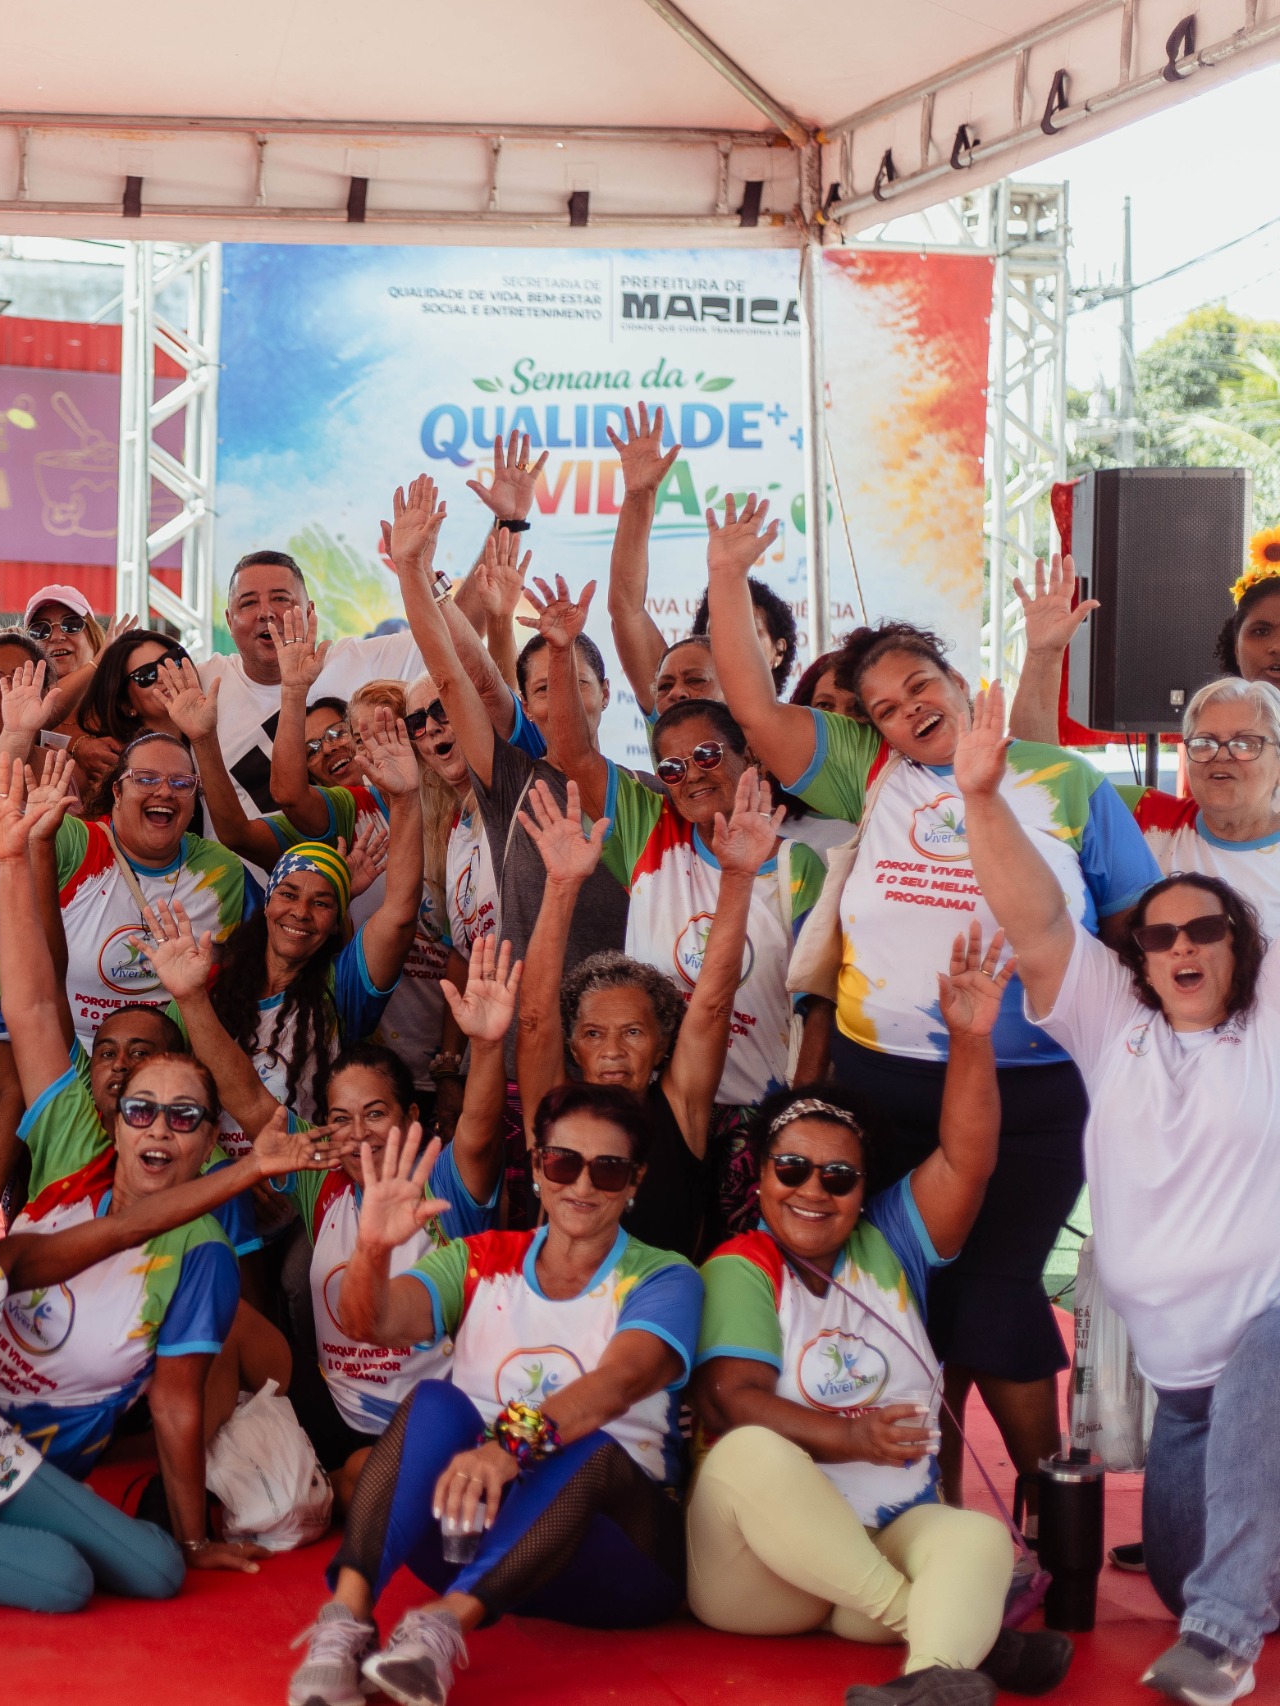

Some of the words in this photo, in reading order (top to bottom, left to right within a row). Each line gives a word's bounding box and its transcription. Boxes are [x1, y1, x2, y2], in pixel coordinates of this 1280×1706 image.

[502, 276, 581, 290] SECRETARIA
[584, 280, 601, 290] DE
[621, 275, 719, 292] PREFEITURA
[725, 279, 746, 292] DE
[388, 286, 463, 300] QUALIDADE
[469, 290, 485, 300] DE
[422, 302, 466, 315] SOCIAL
[472, 304, 479, 315] E
[484, 304, 602, 321] ENTRETENIMENTO
[510, 357, 631, 395] Semana
[640, 358, 688, 390] da
[875, 860, 928, 873] PORQUE
[931, 866, 975, 879] VIVER
[876, 873, 885, 884] É
[887, 875, 897, 885] O
[899, 877, 929, 889] SEU
[931, 881, 984, 896] MELHO
[885, 891, 976, 912] PROGRAMA!
[75, 993, 122, 1008] PORQUE
[81, 1007, 89, 1018] É
[90, 1011, 100, 1020] O
